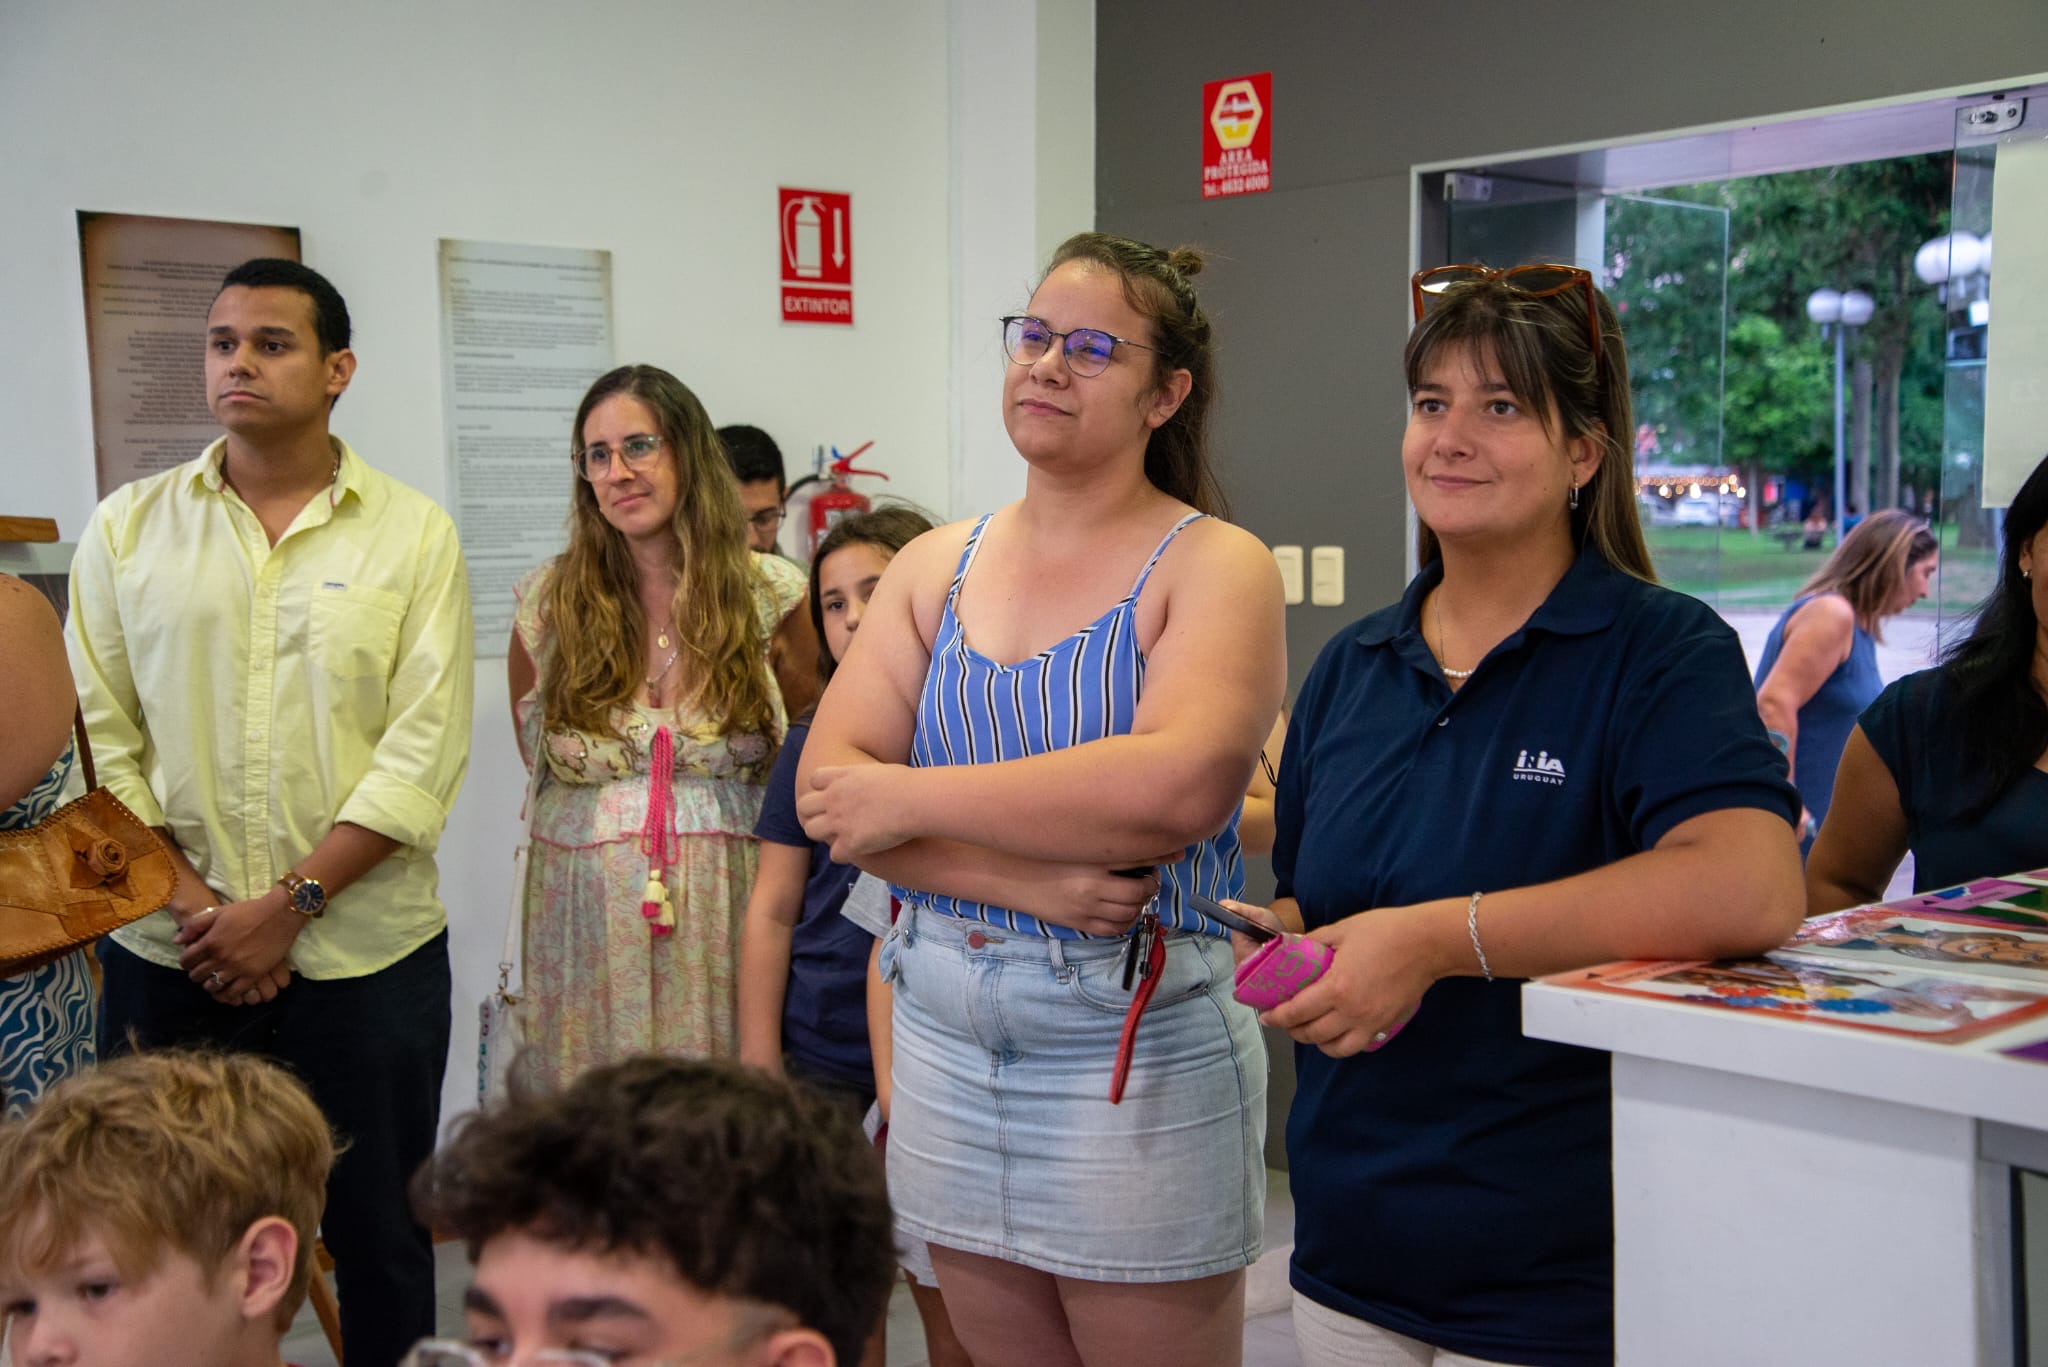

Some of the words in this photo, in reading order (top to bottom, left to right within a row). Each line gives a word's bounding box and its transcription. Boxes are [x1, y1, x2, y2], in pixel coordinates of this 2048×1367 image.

[1219, 148, 1253, 166] AREA
[1204, 159, 1268, 181] PROTEGIDA
[784, 295, 849, 314] EXTINTOR
[1513, 773, 1564, 785] URUGUAY
